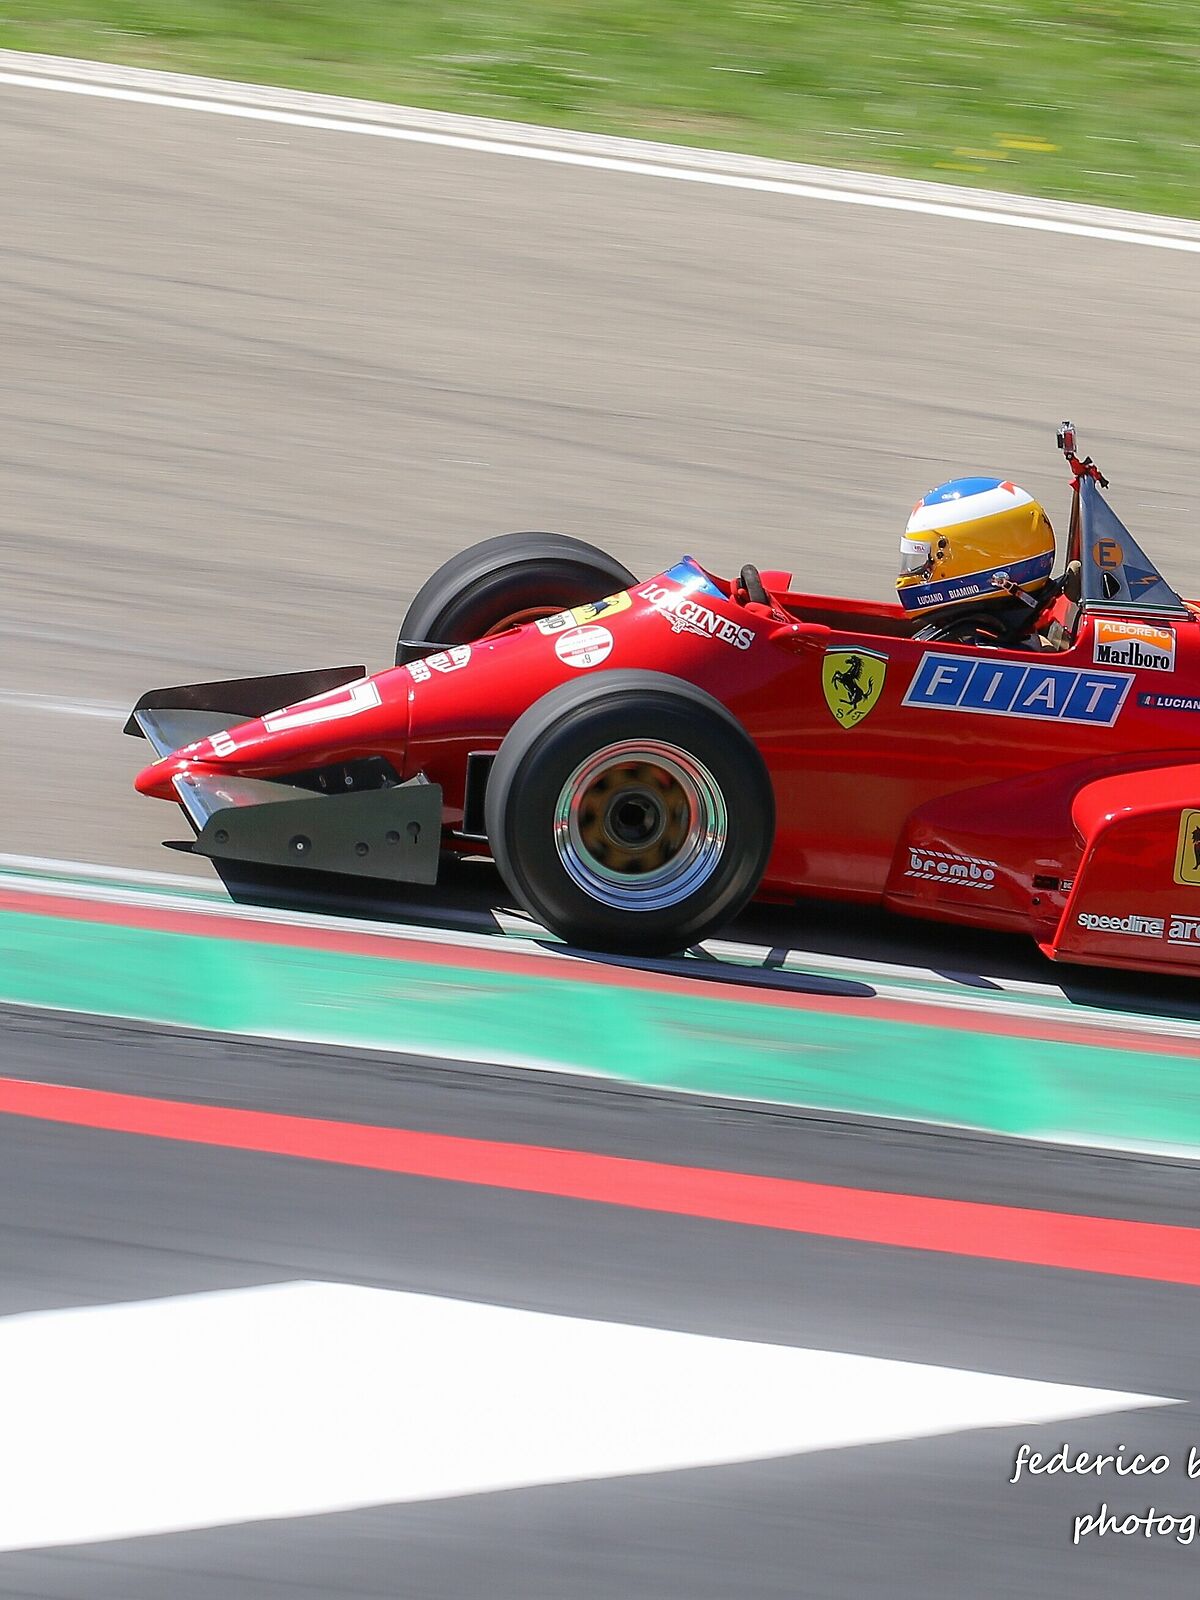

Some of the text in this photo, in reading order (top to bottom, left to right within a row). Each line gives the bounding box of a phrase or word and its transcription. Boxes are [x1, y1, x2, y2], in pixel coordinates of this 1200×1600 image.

[916, 584, 980, 605] LUCIANO BIAMINO
[638, 583, 756, 650] LONGINES
[1102, 623, 1171, 639] ALBORETO
[1096, 642, 1170, 670] Marlboro
[924, 664, 1118, 714] FIAT
[910, 854, 995, 881] brembo
[1077, 912, 1165, 936] speedline
